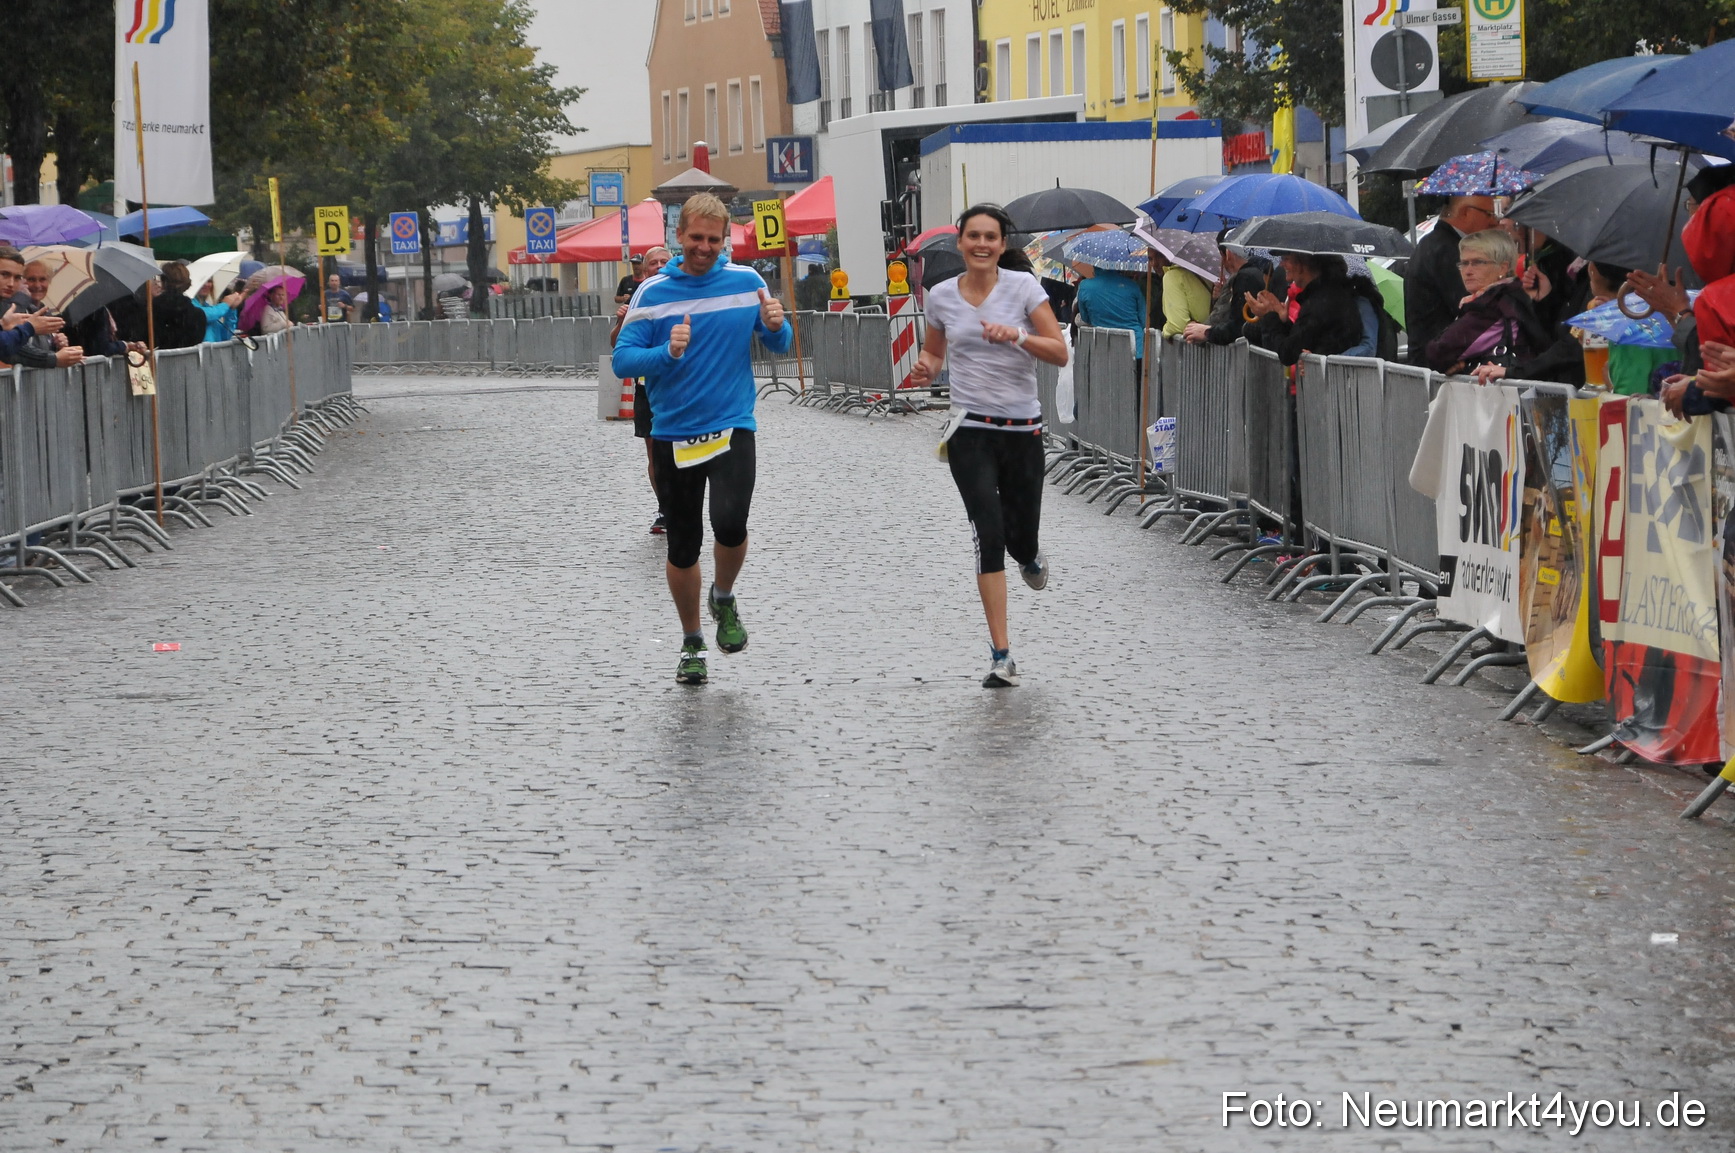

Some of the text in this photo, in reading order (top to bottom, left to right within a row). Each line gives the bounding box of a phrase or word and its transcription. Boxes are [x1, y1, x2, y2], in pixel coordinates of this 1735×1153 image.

[1406, 12, 1457, 24] Ulmer Gasse
[1477, 24, 1513, 32] Marktplatz
[161, 123, 204, 134] neumarkt
[757, 201, 781, 212] Block
[319, 209, 344, 218] Block
[325, 221, 341, 244] D
[762, 215, 779, 239] D
[394, 241, 417, 250] TAXI
[530, 239, 554, 250] TAXI
